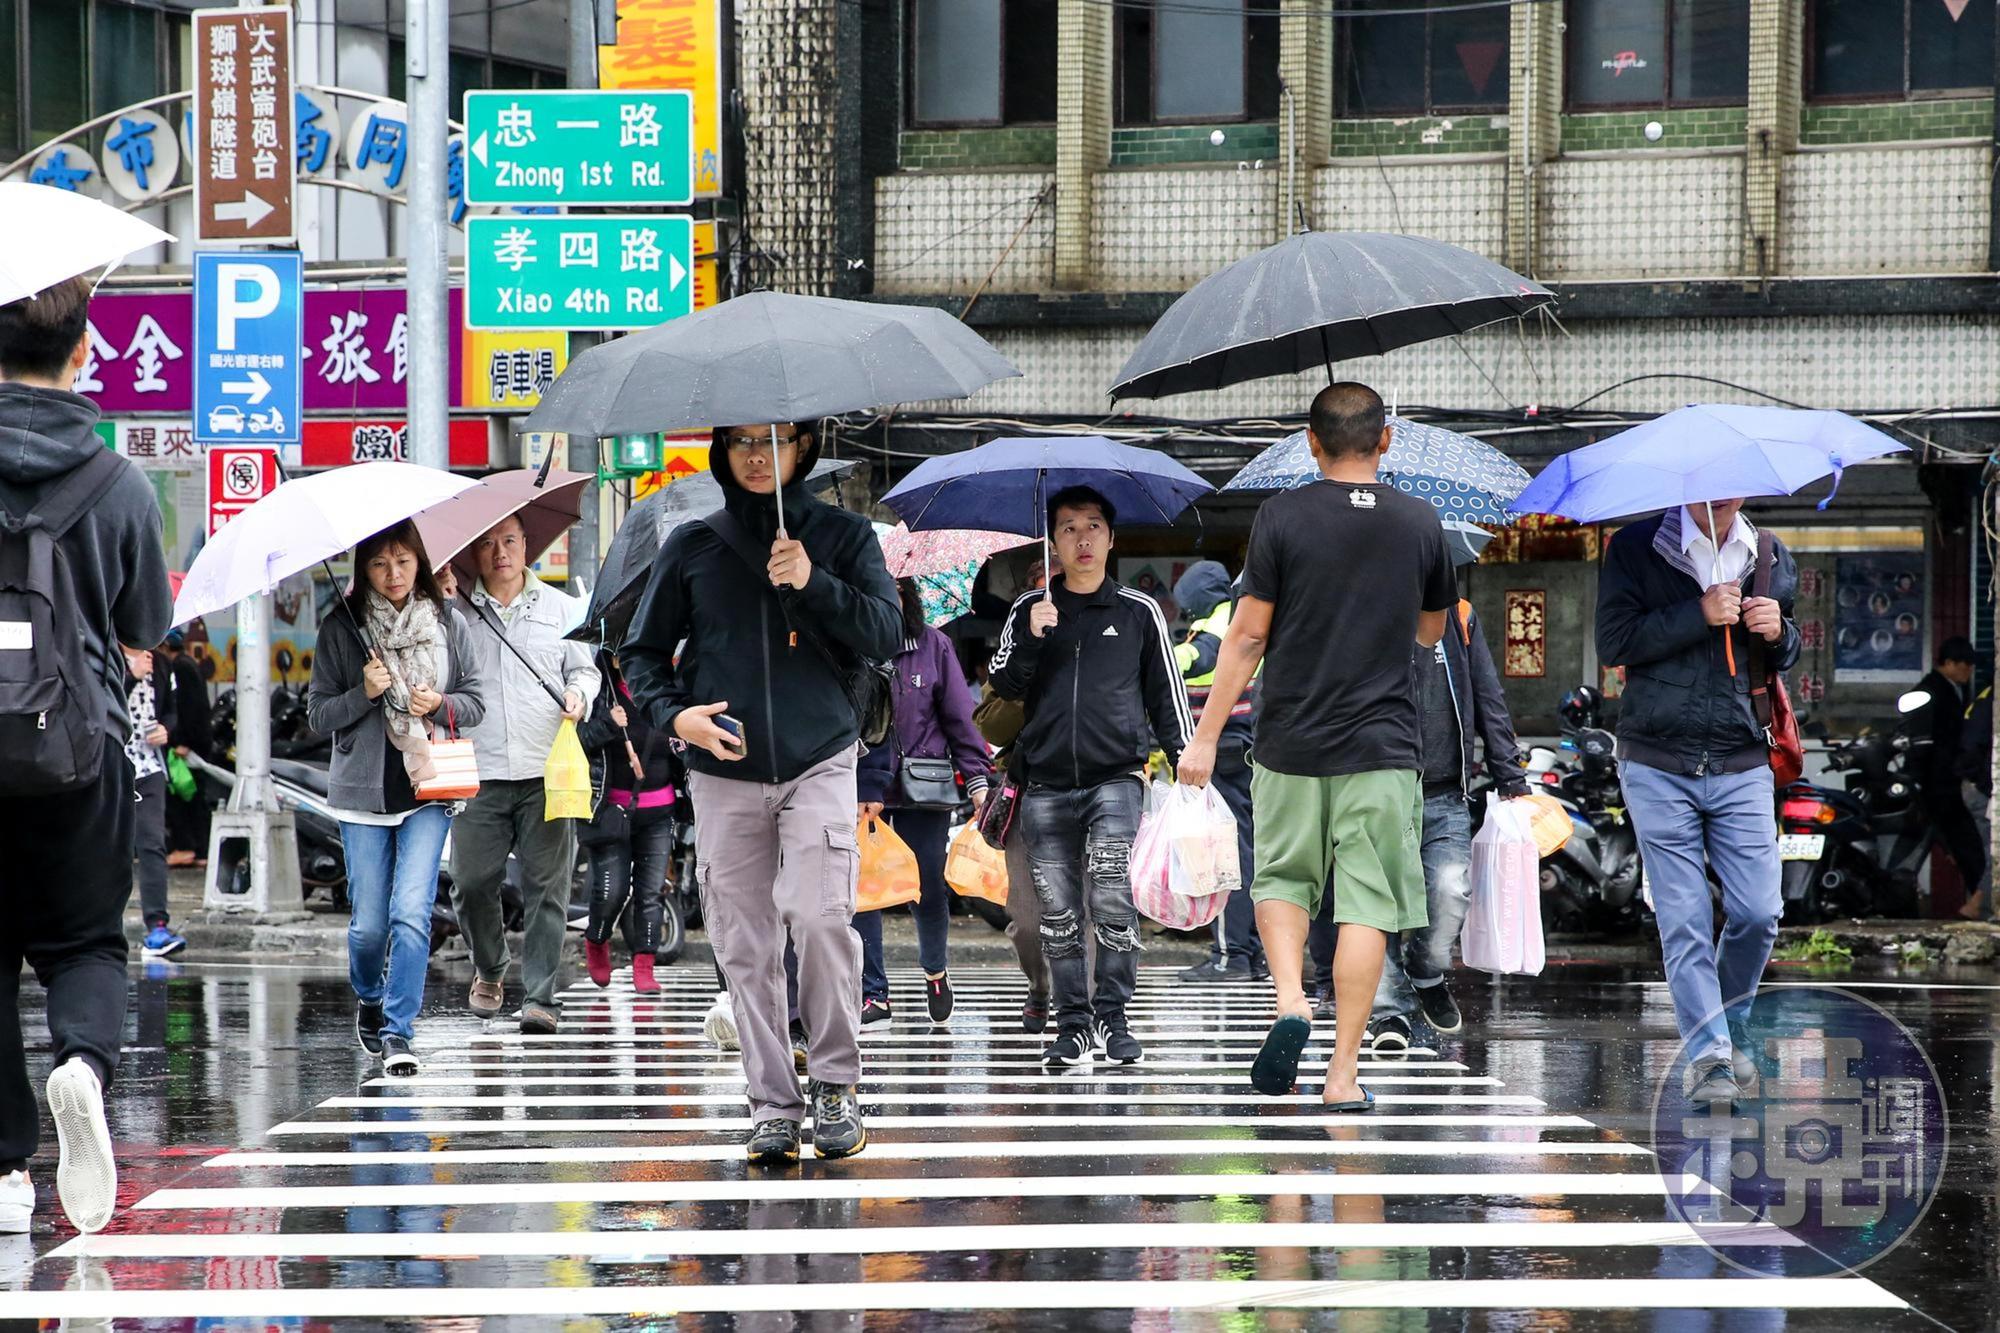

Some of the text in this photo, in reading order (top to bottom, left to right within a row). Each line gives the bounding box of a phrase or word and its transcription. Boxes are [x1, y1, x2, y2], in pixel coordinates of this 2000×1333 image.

[210, 25, 238, 181] 獅球嶺隧道
[250, 25, 279, 180] 大武崙砲台
[494, 103, 662, 147] 忠一路
[495, 161, 665, 195] Zhong 1st Rd.
[494, 227, 663, 272] 孝四路
[216, 263, 281, 351] P
[496, 287, 664, 313] Xiao 4th Rd.
[490, 349, 554, 401] 停車場
[126, 426, 206, 460] 醒來
